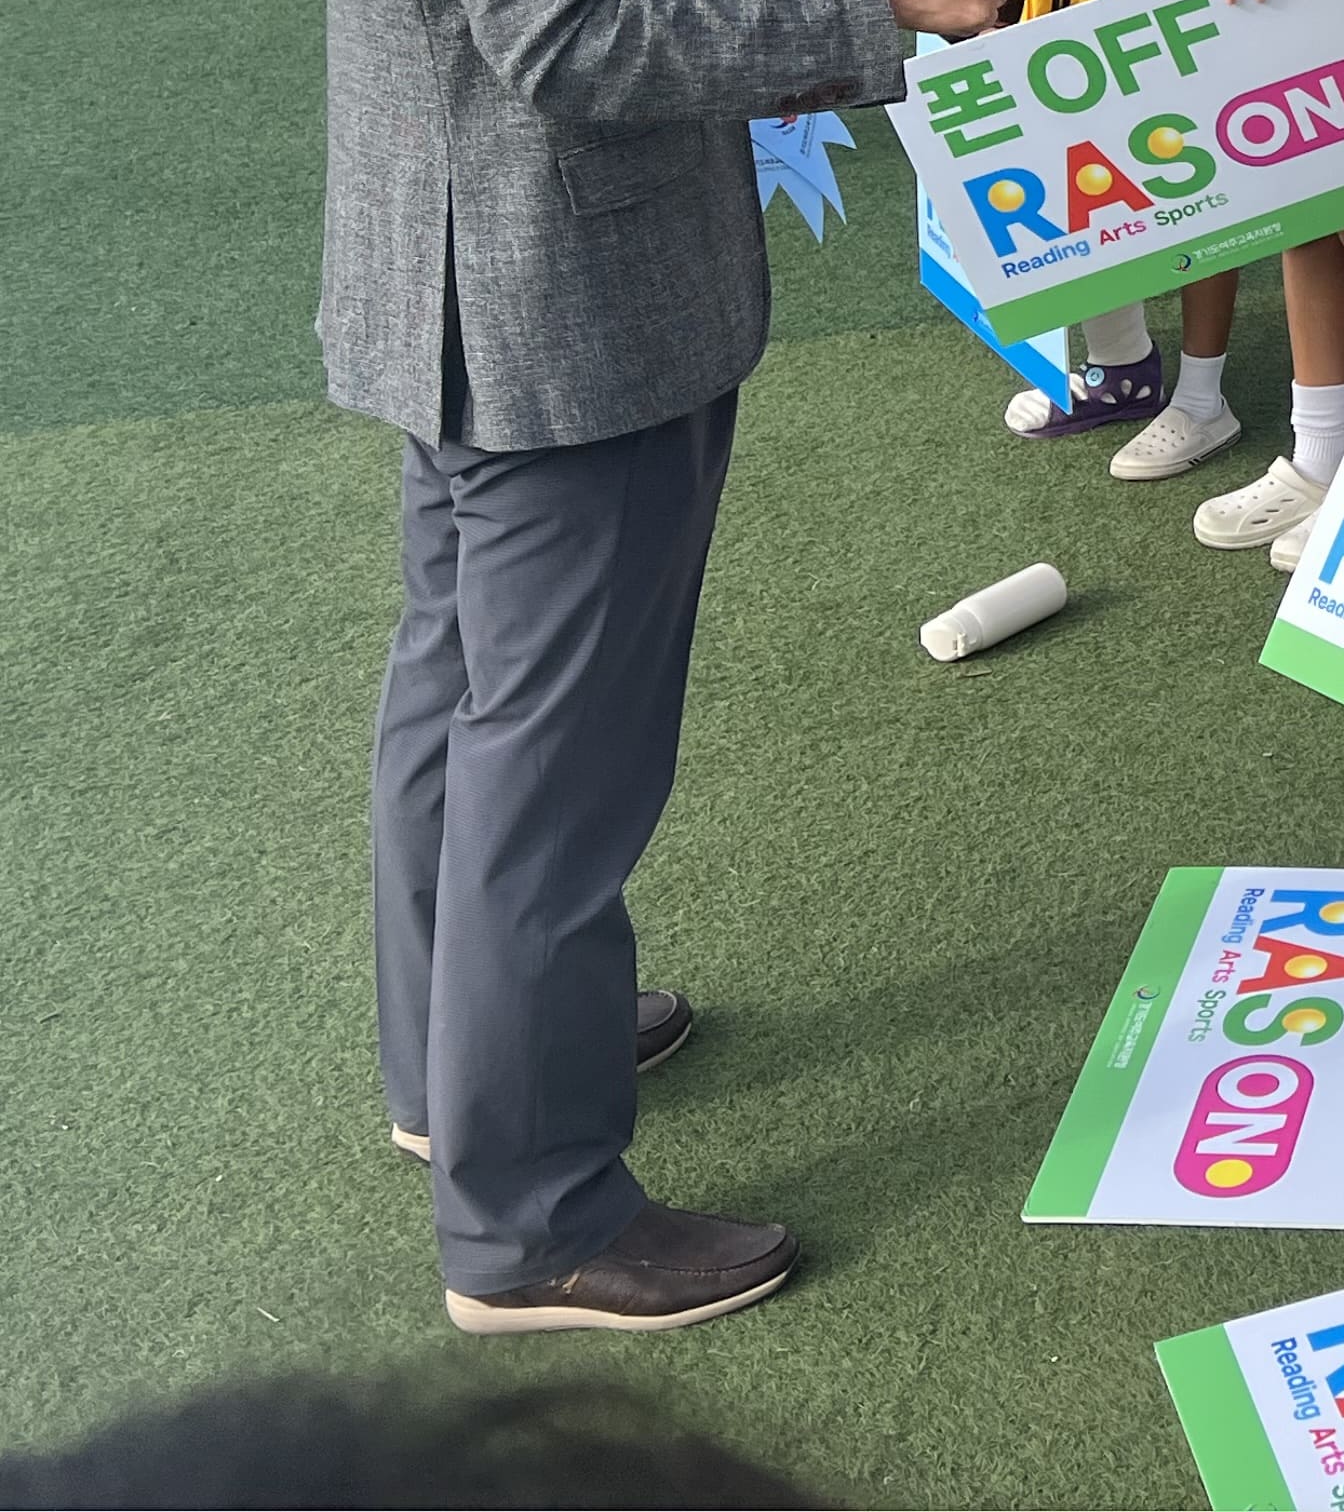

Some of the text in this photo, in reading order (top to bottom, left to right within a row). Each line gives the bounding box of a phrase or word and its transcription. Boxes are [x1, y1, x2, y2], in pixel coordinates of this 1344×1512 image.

[918, 59, 1023, 158] 폰
[963, 113, 1217, 258] RAS
[1001, 190, 1229, 278] Reading Arts Sports
[1187, 886, 1266, 1044] Reading Arts Sports
[1194, 1060, 1300, 1157] ON
[1270, 1336, 1321, 1421] Reading
